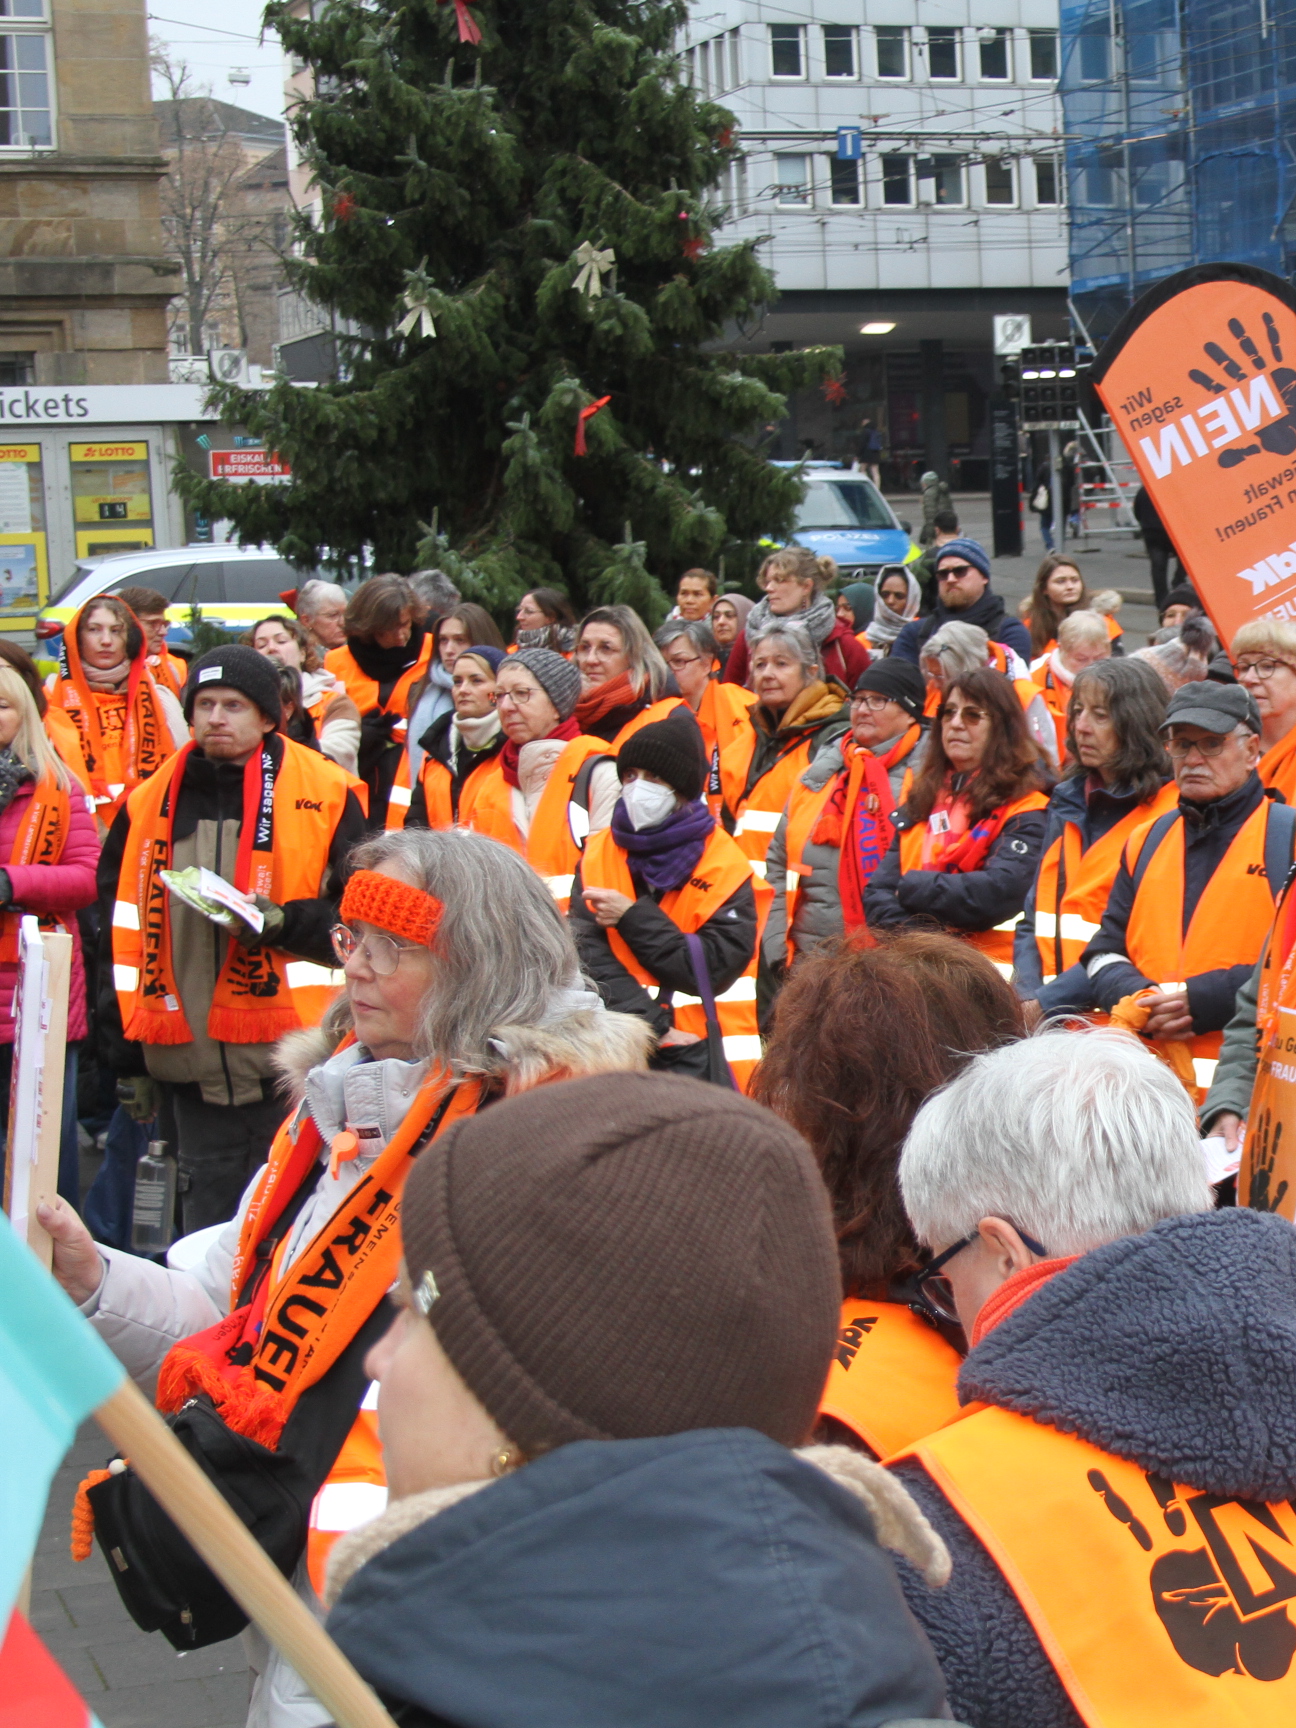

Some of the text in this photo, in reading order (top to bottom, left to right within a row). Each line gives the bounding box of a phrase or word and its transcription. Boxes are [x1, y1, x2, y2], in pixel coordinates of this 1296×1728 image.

[0, 390, 89, 419] ickets
[0, 448, 28, 459] OTTO
[99, 446, 136, 457] LOTTO
[809, 532, 881, 542] POLIZEI
[263, 773, 274, 815] sagen
[257, 817, 271, 844] Wir
[255, 865, 268, 894] ewalt
[688, 874, 714, 892] dK
[837, 1316, 880, 1372] VdK
